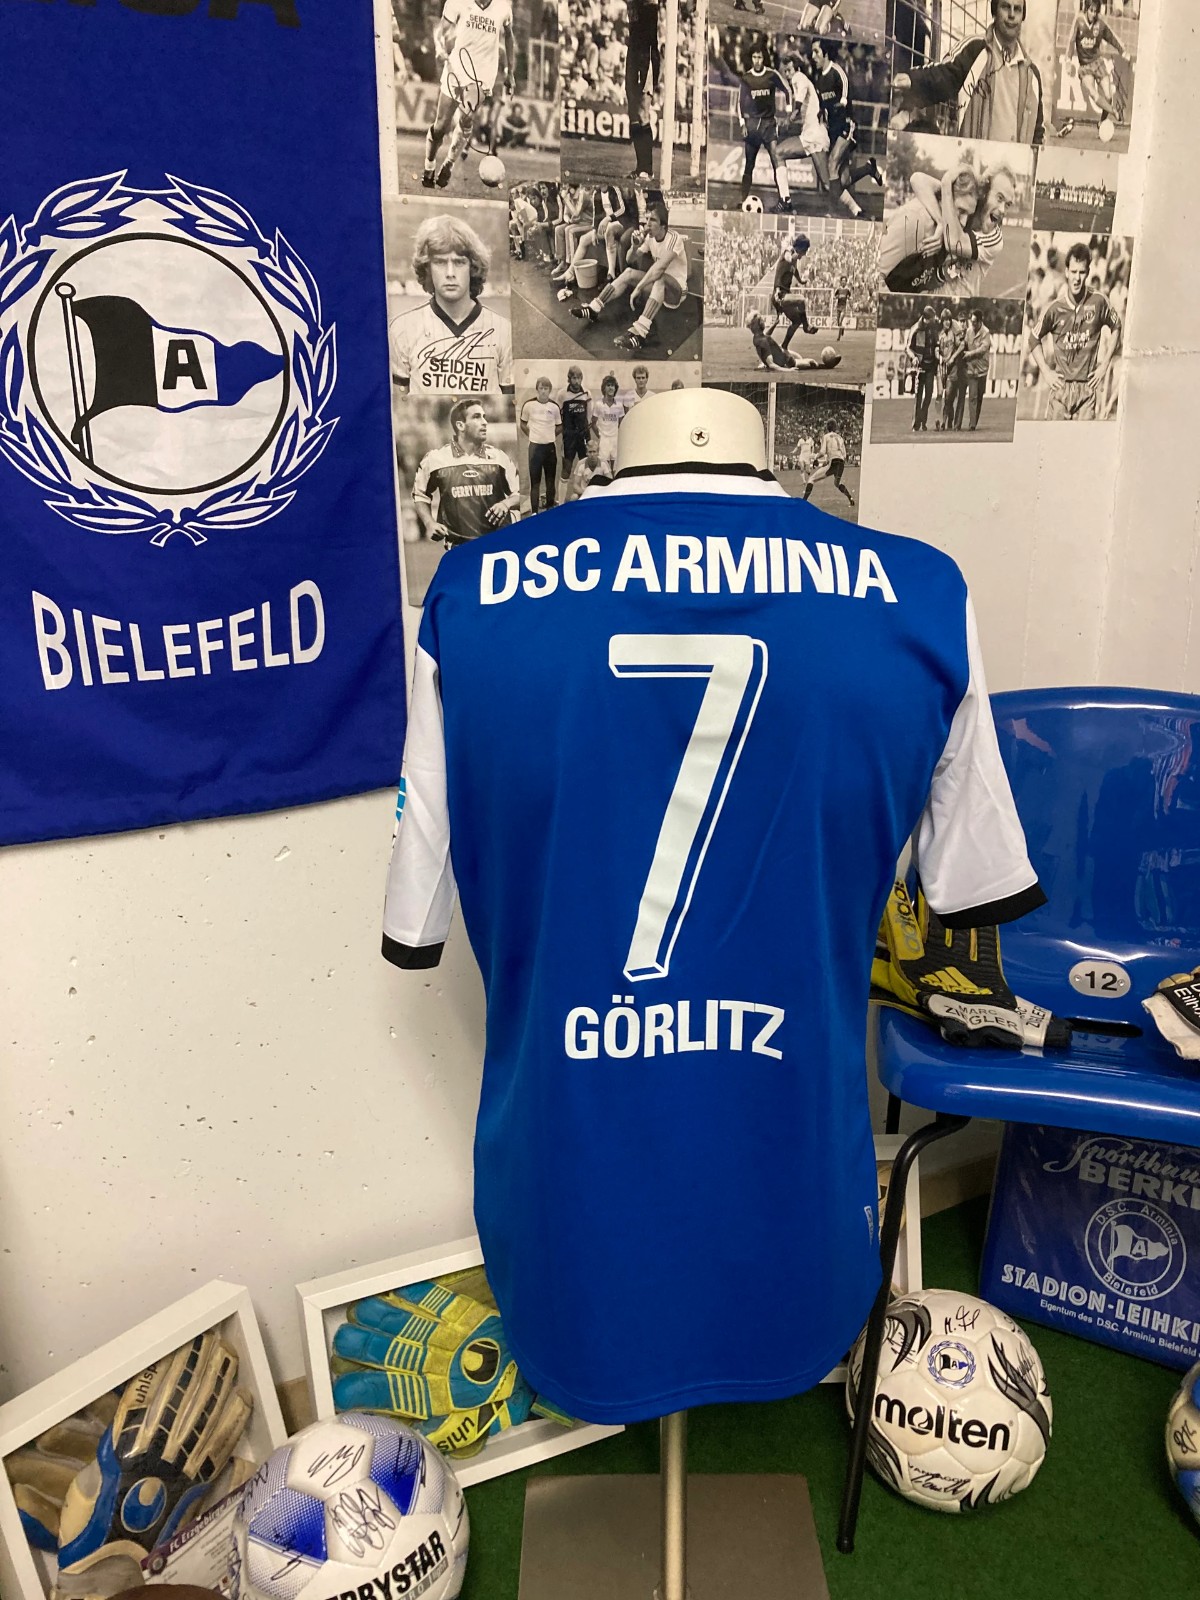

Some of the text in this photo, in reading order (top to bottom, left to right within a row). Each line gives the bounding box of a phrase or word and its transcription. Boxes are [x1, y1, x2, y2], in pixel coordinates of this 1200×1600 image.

[466, 21, 497, 34] STICKER
[469, 14, 495, 26] SEIDEN
[163, 339, 207, 389] A
[422, 372, 489, 392] STICKER
[429, 358, 485, 377] SEIDEN
[480, 534, 898, 605] DSC ARMINIA
[32, 579, 326, 691] BIELEFELD
[608, 634, 768, 982] 7
[1085, 970, 1117, 992] 12
[564, 994, 785, 1060] GÖRLITZ
[1141, 1205, 1178, 1245] Arminia
[1103, 1272, 1158, 1296] Bielefeld
[1040, 1299, 1076, 1318] Eigentum
[1078, 1312, 1093, 1323] des
[1122, 1327, 1155, 1344] Arminia
[1158, 1337, 1197, 1357] Bielefeld
[874, 1393, 1011, 1451] molten
[169, 1538, 181, 1553] FC
